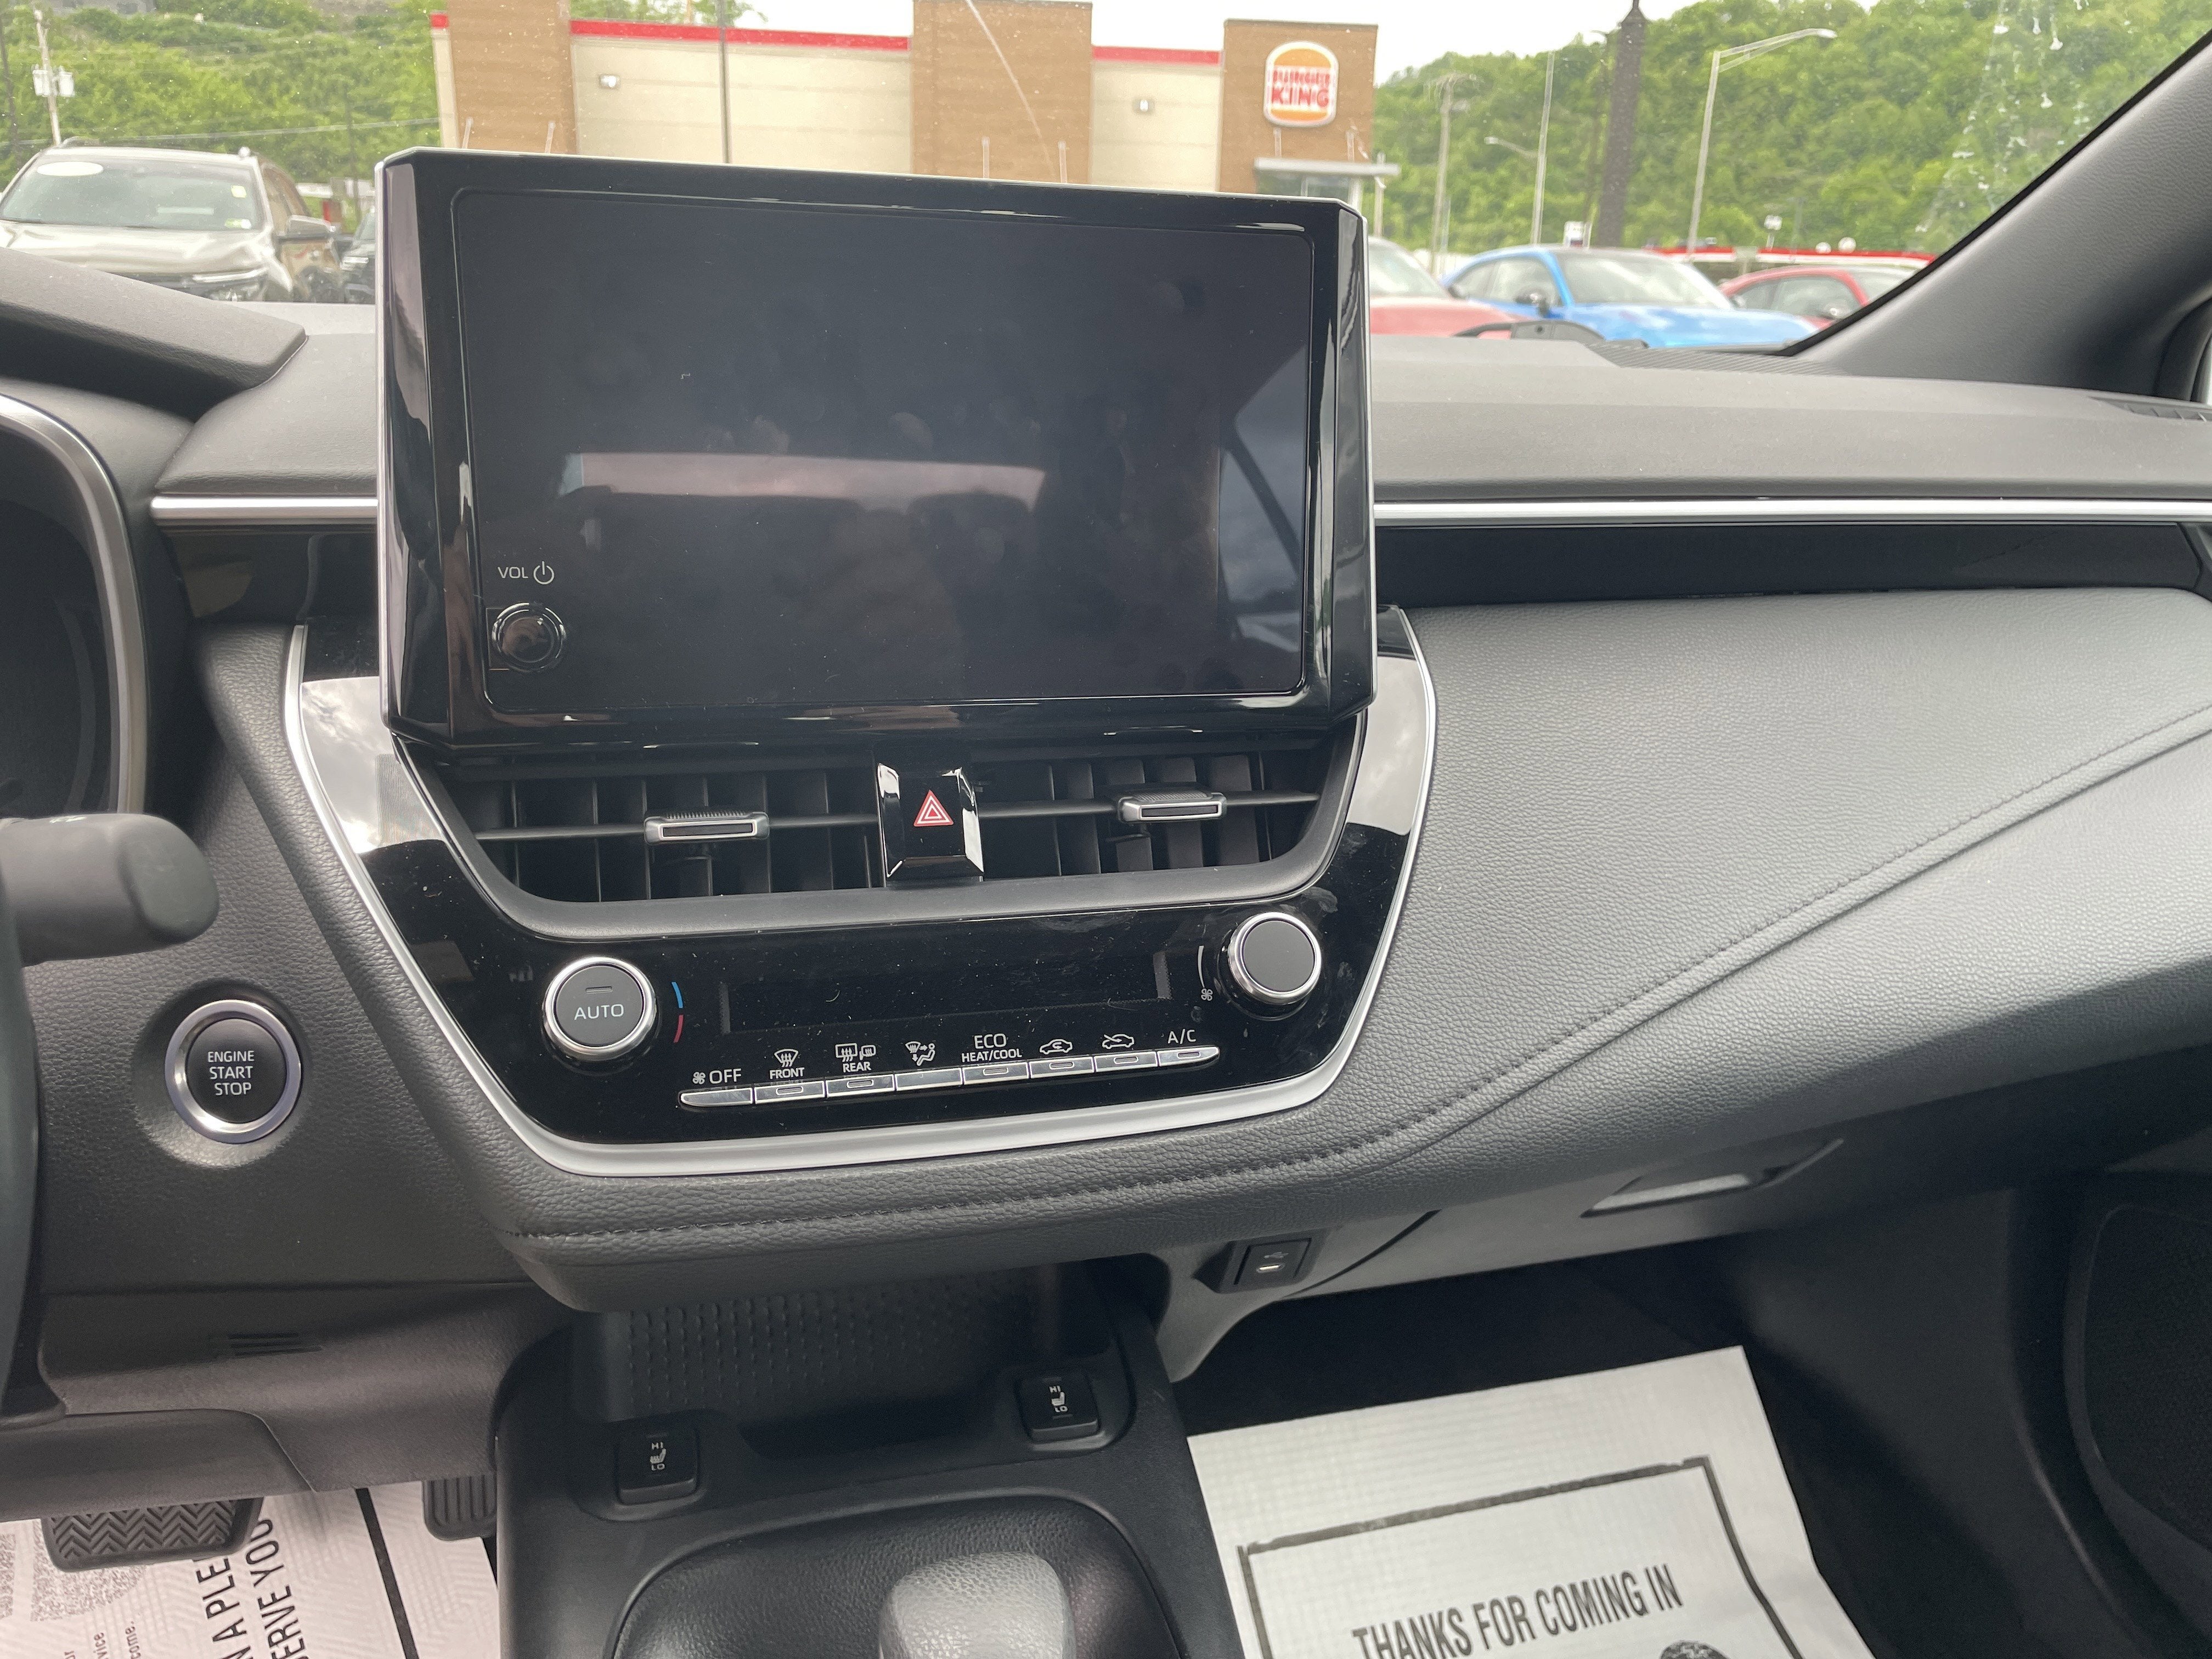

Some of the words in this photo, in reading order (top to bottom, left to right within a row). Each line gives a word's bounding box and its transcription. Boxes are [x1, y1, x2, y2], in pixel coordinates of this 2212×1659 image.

[1271, 86, 1329, 108] KING
[497, 566, 529, 579] VOL
[574, 1003, 625, 1020] AUTO
[973, 1033, 1007, 1049] ECO
[1167, 1029, 1197, 1045] A/C
[207, 1050, 255, 1063] ENGINE
[961, 1048, 1023, 1063] HEAT/COOL
[209, 1065, 253, 1080] START
[769, 1067, 805, 1080] FRONT
[842, 1061, 872, 1073] REAR
[709, 1068, 742, 1084] OFF
[214, 1082, 252, 1096] STOP
[651, 1442, 664, 1450] HI
[246, 1519, 285, 1588] YOU
[1351, 1607, 1472, 1659] THANKS
[1471, 1595, 1537, 1650] FOR
[1536, 1570, 1649, 1636] COMING
[1645, 1563, 1684, 1611] IN
[257, 1585, 309, 1659] ERVE
